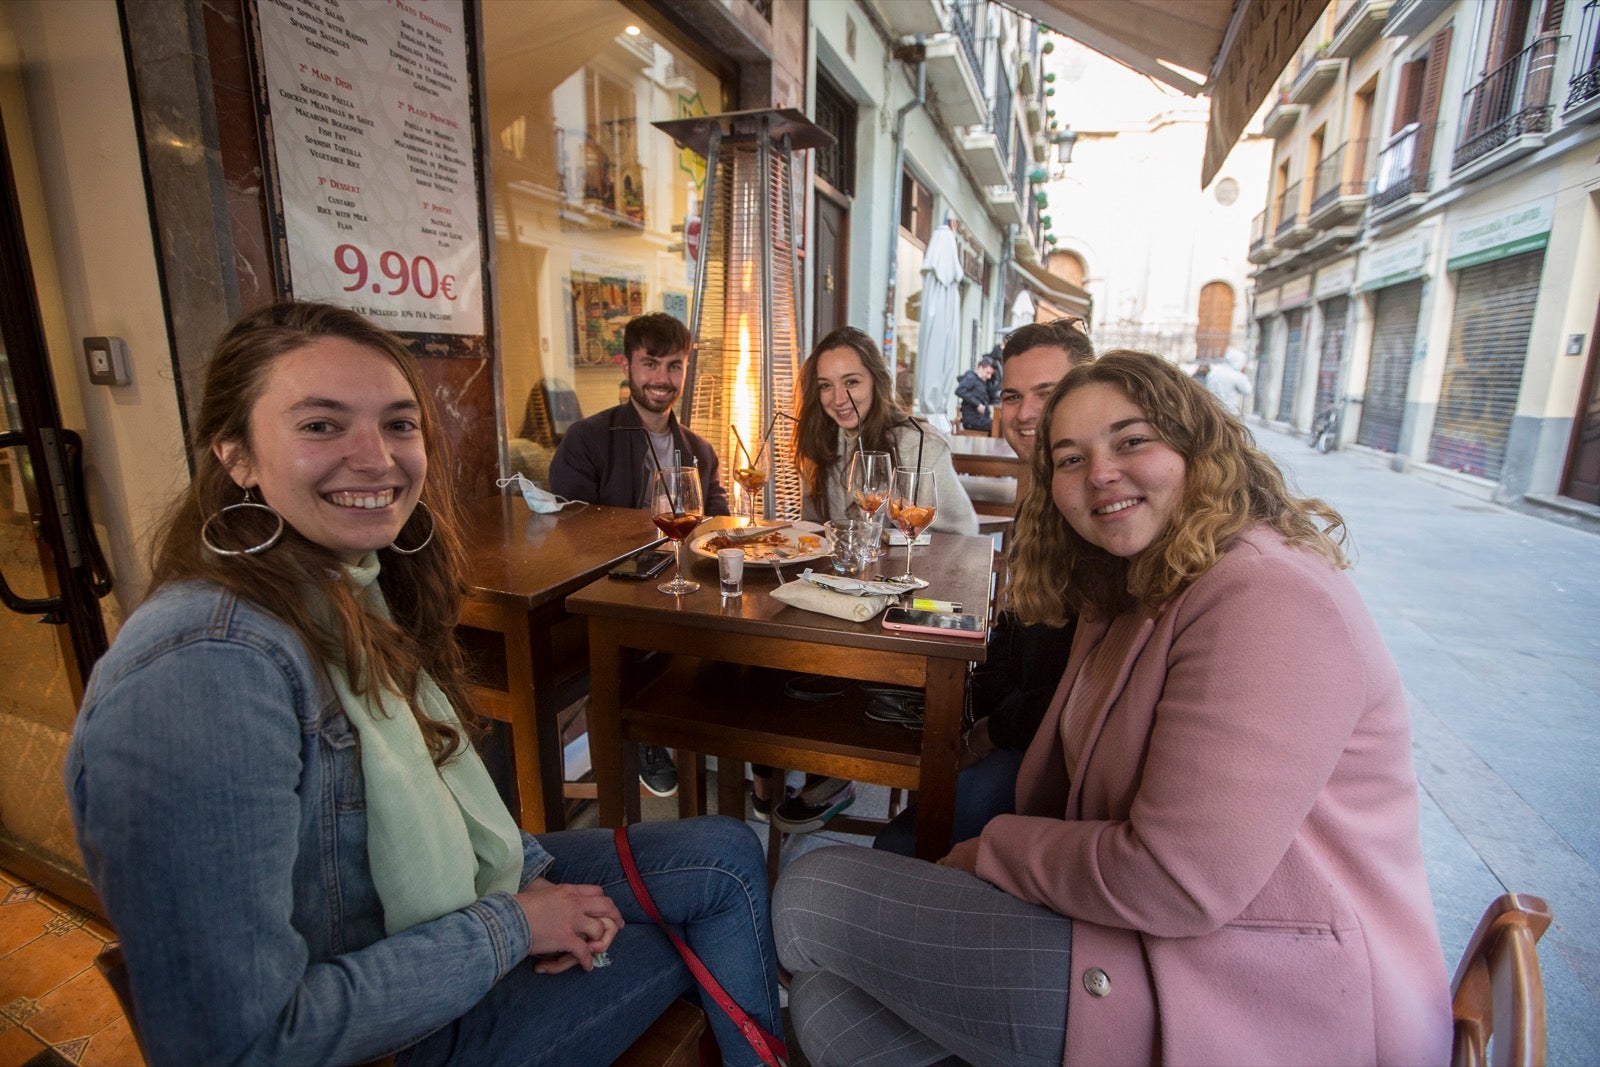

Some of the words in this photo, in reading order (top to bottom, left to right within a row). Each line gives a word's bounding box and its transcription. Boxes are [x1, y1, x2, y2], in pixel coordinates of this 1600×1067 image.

[324, 8, 344, 22] SALAD
[420, 11, 452, 33] ENTRANTES
[290, 17, 317, 34] SPANISH
[320, 30, 350, 49] SAUSAGES
[296, 8, 324, 25] SPINACH
[327, 22, 343, 34] WITH
[346, 30, 368, 45] RAISINS
[401, 20, 415, 32] SOPA
[306, 37, 338, 56] GAZPACHO
[426, 54, 448, 69] TROPICAL
[398, 64, 414, 76] TABLA
[312, 67, 332, 82] MAIN
[336, 76, 352, 90] DISH
[300, 83, 329, 99] SEAFOOD
[332, 94, 354, 108] PAELLA
[414, 82, 440, 97] GAZPACHO
[280, 88, 308, 104] CHICKEN
[310, 100, 346, 118] MEATBALLS
[356, 115, 374, 126] SAUCE
[408, 104, 428, 118] PLATO
[296, 106, 328, 124] MACARONI
[332, 118, 364, 135] BOLOGNESE
[404, 120, 423, 132] PAELLA
[318, 126, 332, 136] FISH
[335, 132, 346, 141] FRY
[305, 135, 331, 149] SPANISH
[334, 144, 362, 158] TORTILLA
[309, 149, 344, 165] VEGETABLE
[346, 160, 360, 169] RICE
[410, 165, 432, 178] TORTILLA
[434, 172, 458, 184] ESPAÑOLA
[330, 179, 360, 194] DESSERT
[328, 196, 356, 208] CUSTARD
[317, 206, 332, 216] RICE
[336, 210, 351, 219] WITH
[353, 212, 368, 222] MILK
[337, 222, 353, 230] FLAN
[334, 244, 458, 300] 9.90€
[351, 306, 366, 315] TAX
[370, 308, 398, 317] INCLUDED
